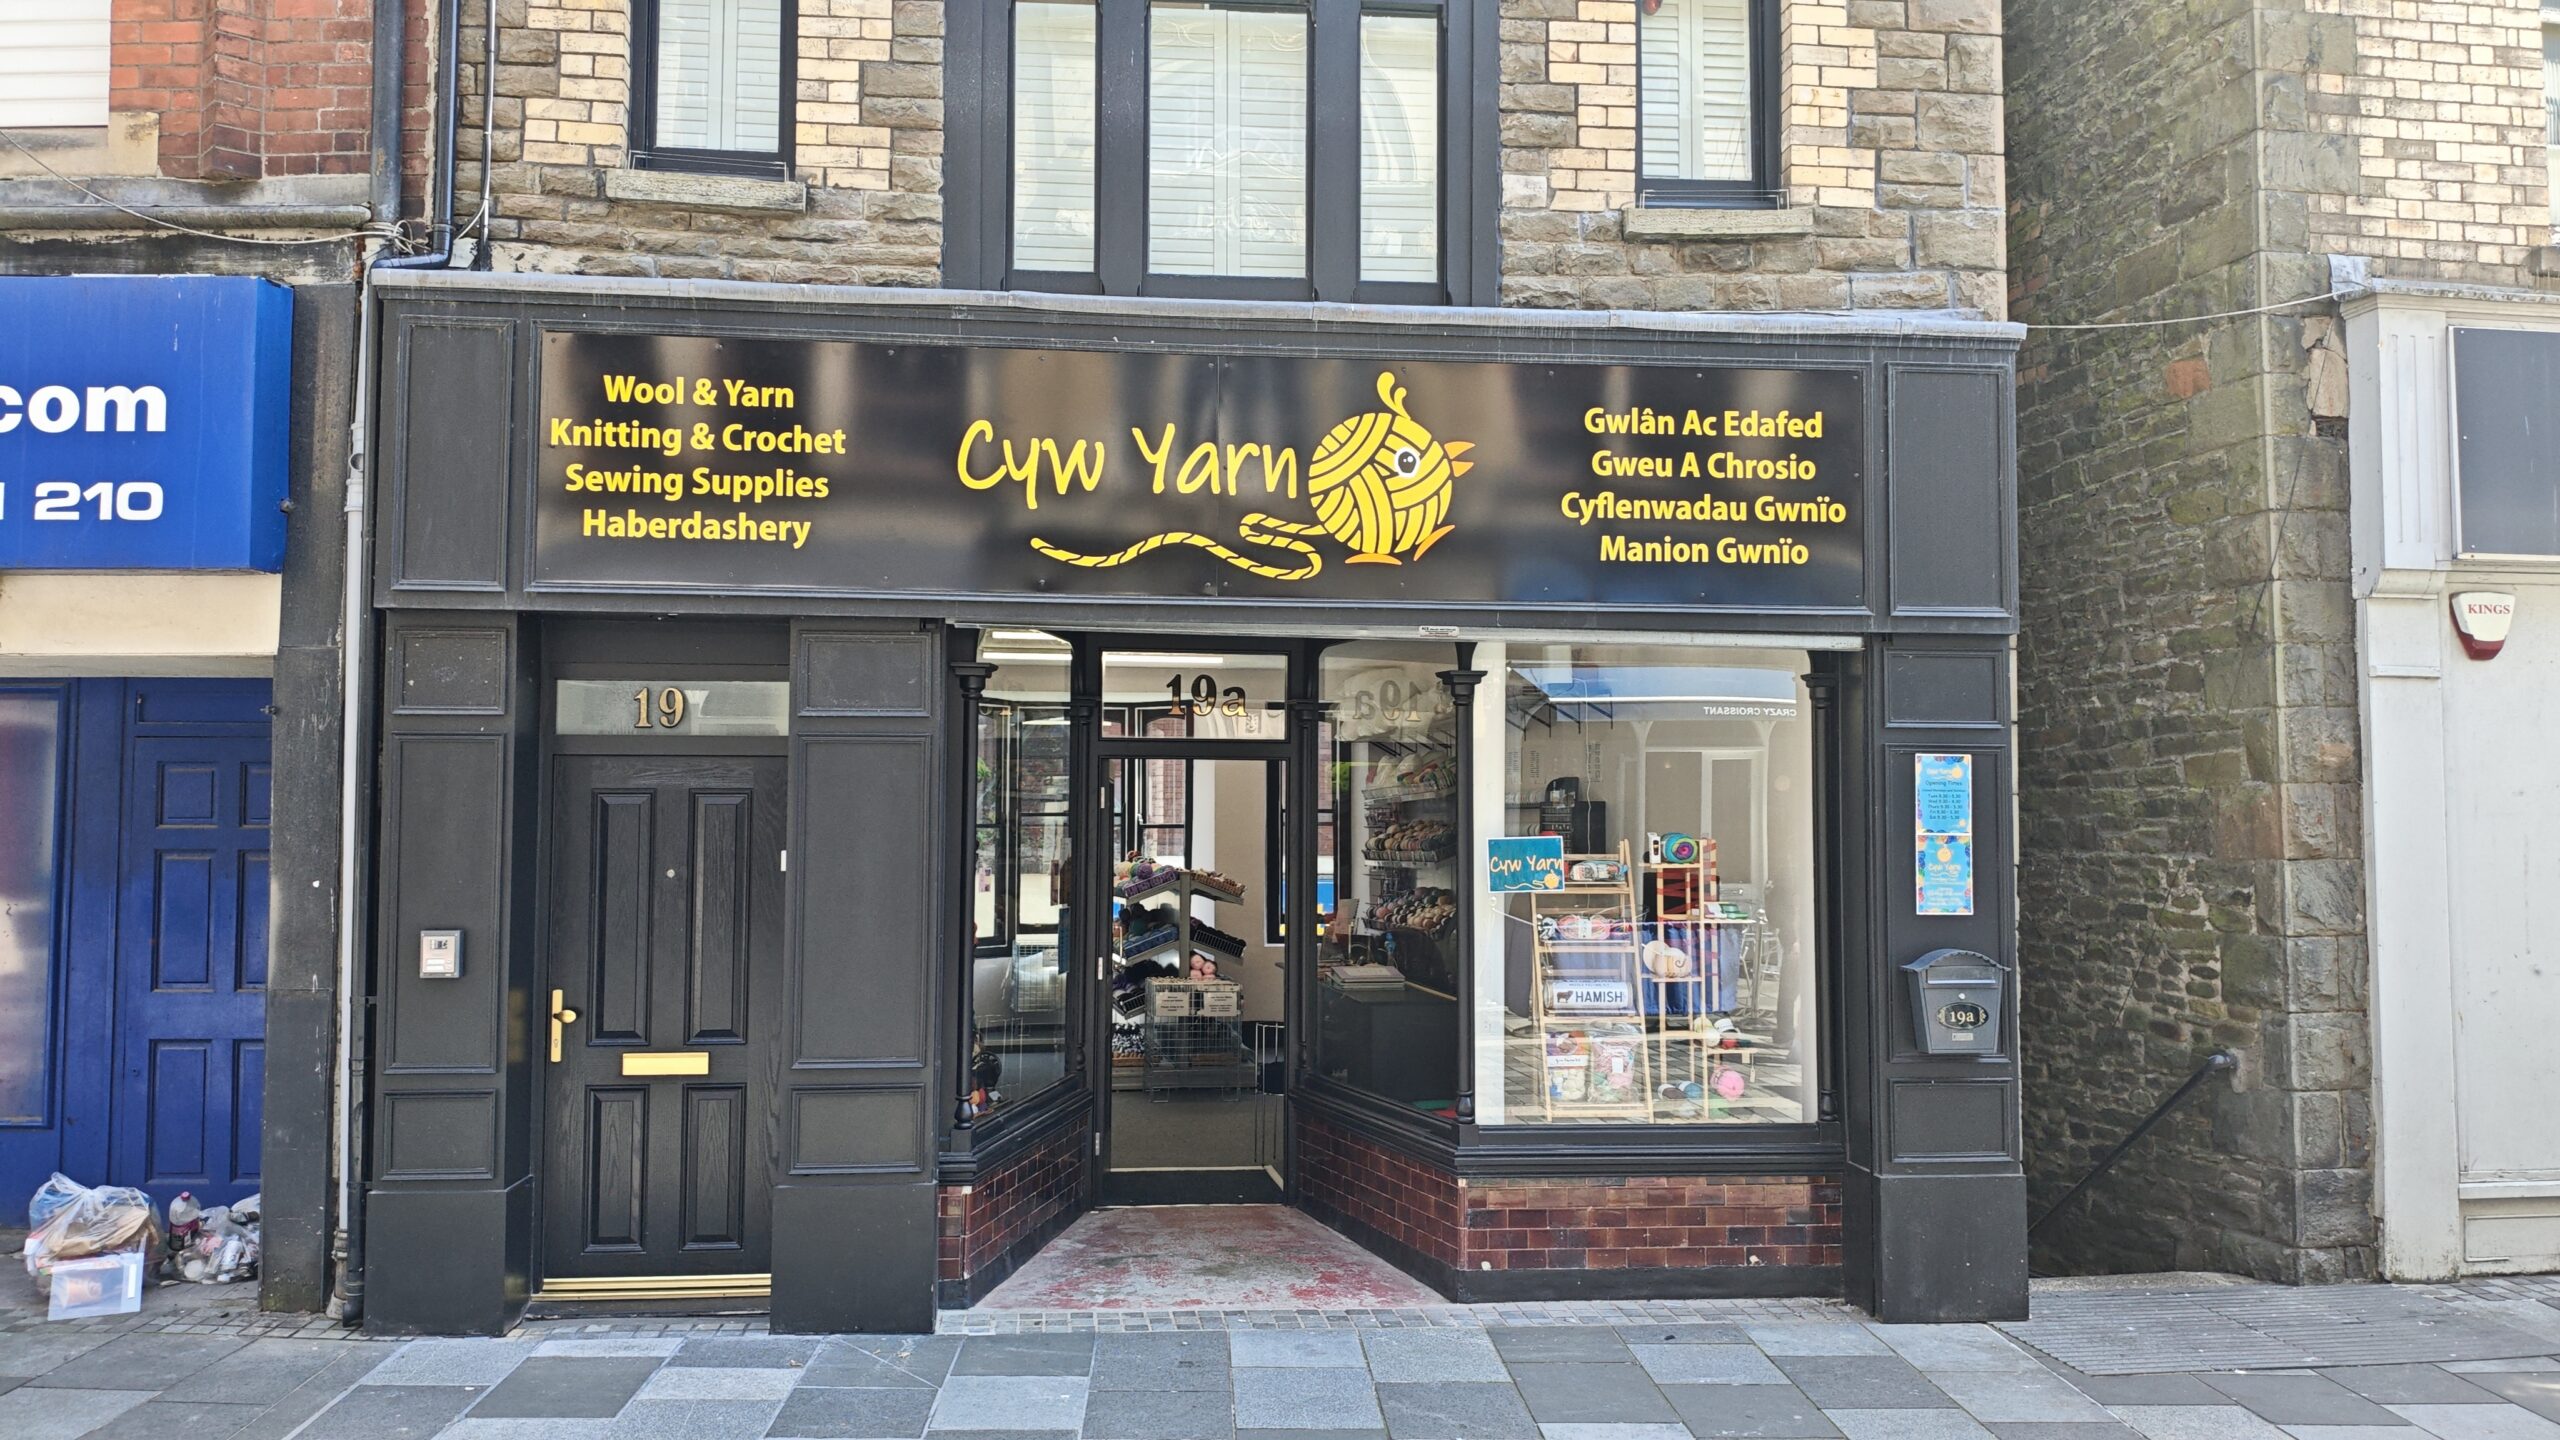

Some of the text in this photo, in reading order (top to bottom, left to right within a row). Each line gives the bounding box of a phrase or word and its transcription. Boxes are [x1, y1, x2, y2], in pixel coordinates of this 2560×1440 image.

[603, 374, 794, 408] Wool & Yarn
[550, 418, 846, 456] Knitting & Crochet
[1584, 407, 1823, 438] Gwlân Ac Edafed
[957, 419, 1297, 509] Cyw Yarn
[1591, 450, 1816, 480] Gweu A Chrosio
[565, 464, 829, 503] Sewing Supplies
[34, 481, 163, 521] 210
[1561, 491, 1847, 526] Cyflenwadau Gwnïo
[583, 509, 811, 549] Haberdashery
[1600, 535, 1809, 564] Manion Gwnïo
[2468, 604, 2511, 614] KINGS
[634, 687, 685, 728] 19
[1166, 674, 1248, 718] 19a
[1490, 854, 1562, 876] Cyw Yarn
[1574, 990, 1623, 1003] HAMISH
[1950, 1011, 1974, 1024] 19a
